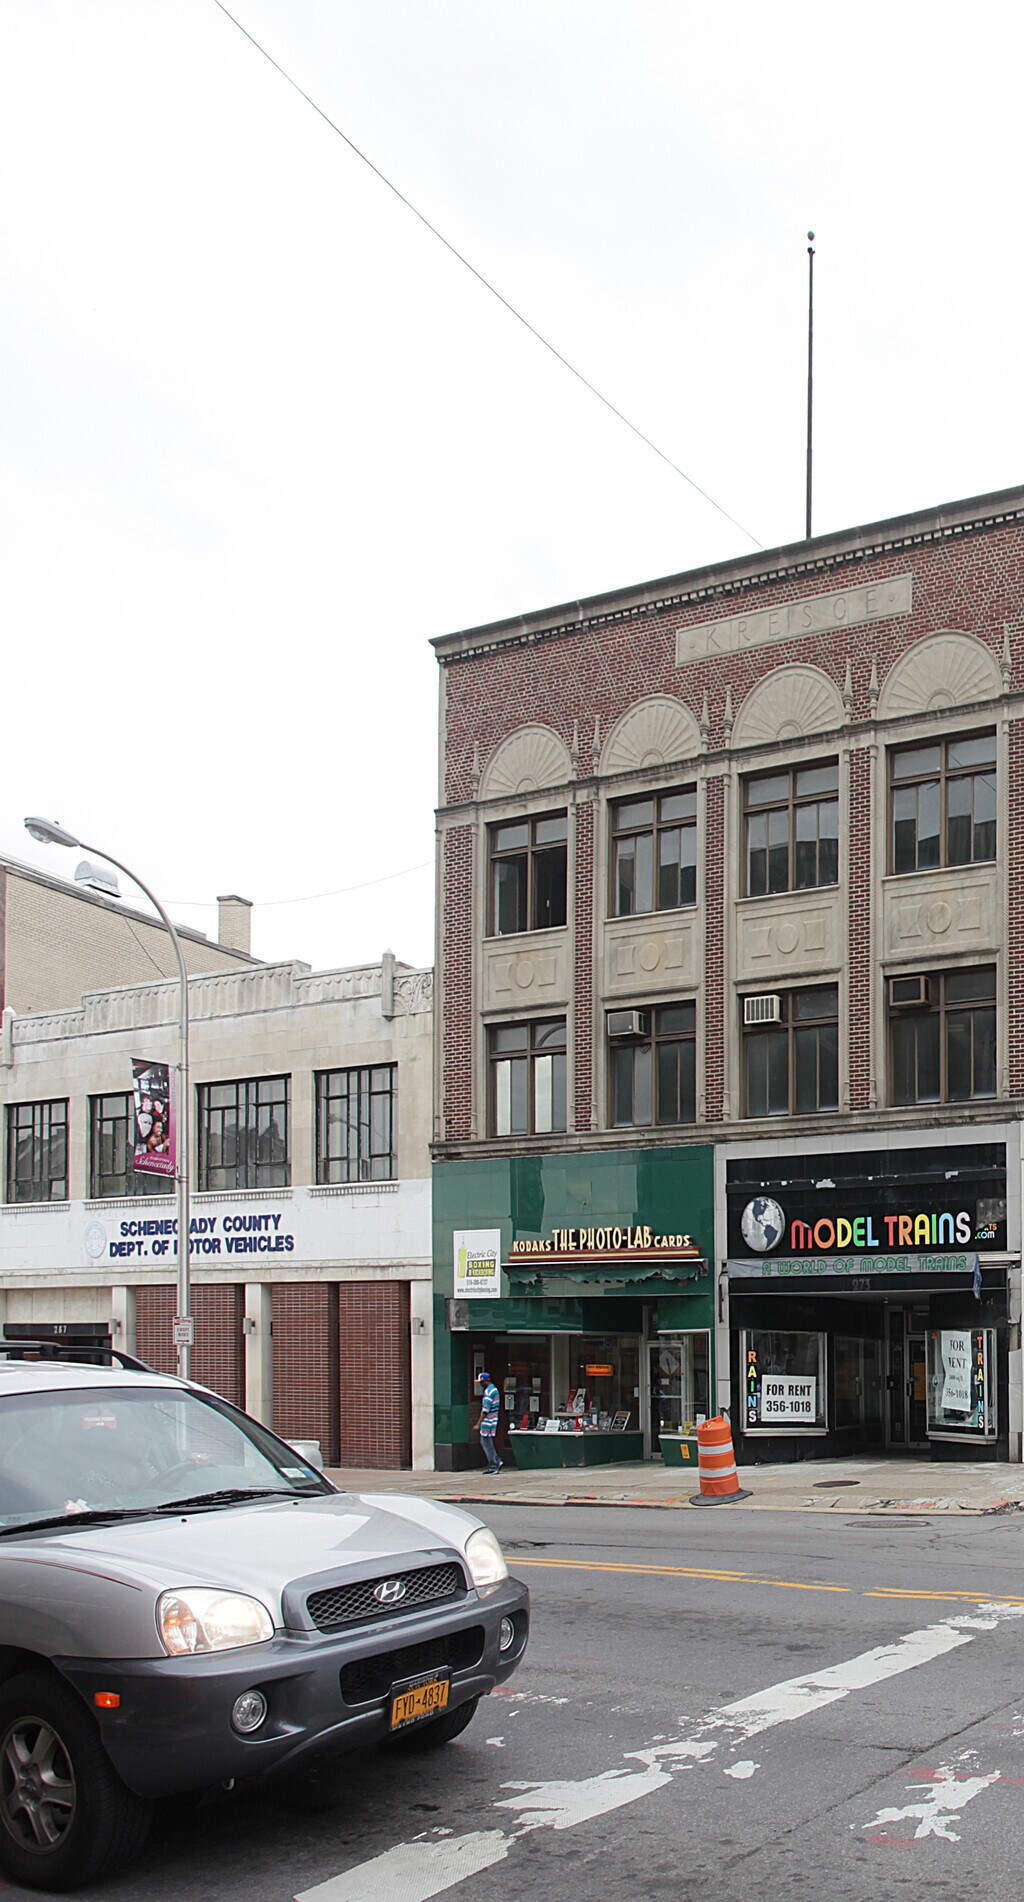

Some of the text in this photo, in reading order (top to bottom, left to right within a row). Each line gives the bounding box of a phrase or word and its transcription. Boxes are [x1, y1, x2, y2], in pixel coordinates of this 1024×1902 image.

[704, 589, 878, 651] KRESGE
[135, 1155, 175, 1173] Schenectady
[120, 1214, 282, 1237] SCHENECADY COUNTY
[791, 1211, 971, 1249] MODEL TRAINS
[109, 1234, 295, 1258] DEPT. OF TOR VEHICLES
[513, 1239, 551, 1252] KODAKS
[552, 1226, 652, 1251] THE PHOTO-LAB
[654, 1235, 691, 1248] CARDS
[468, 1261, 495, 1269] BOXING
[761, 1256, 967, 1275] A WORLD OF MODEL TRAINS
[851, 1278, 871, 1290] 273
[766, 1384, 812, 1396] FOR RENT
[976, 1336, 984, 1429] TRAINS
[766, 1400, 811, 1412] 356-1018
